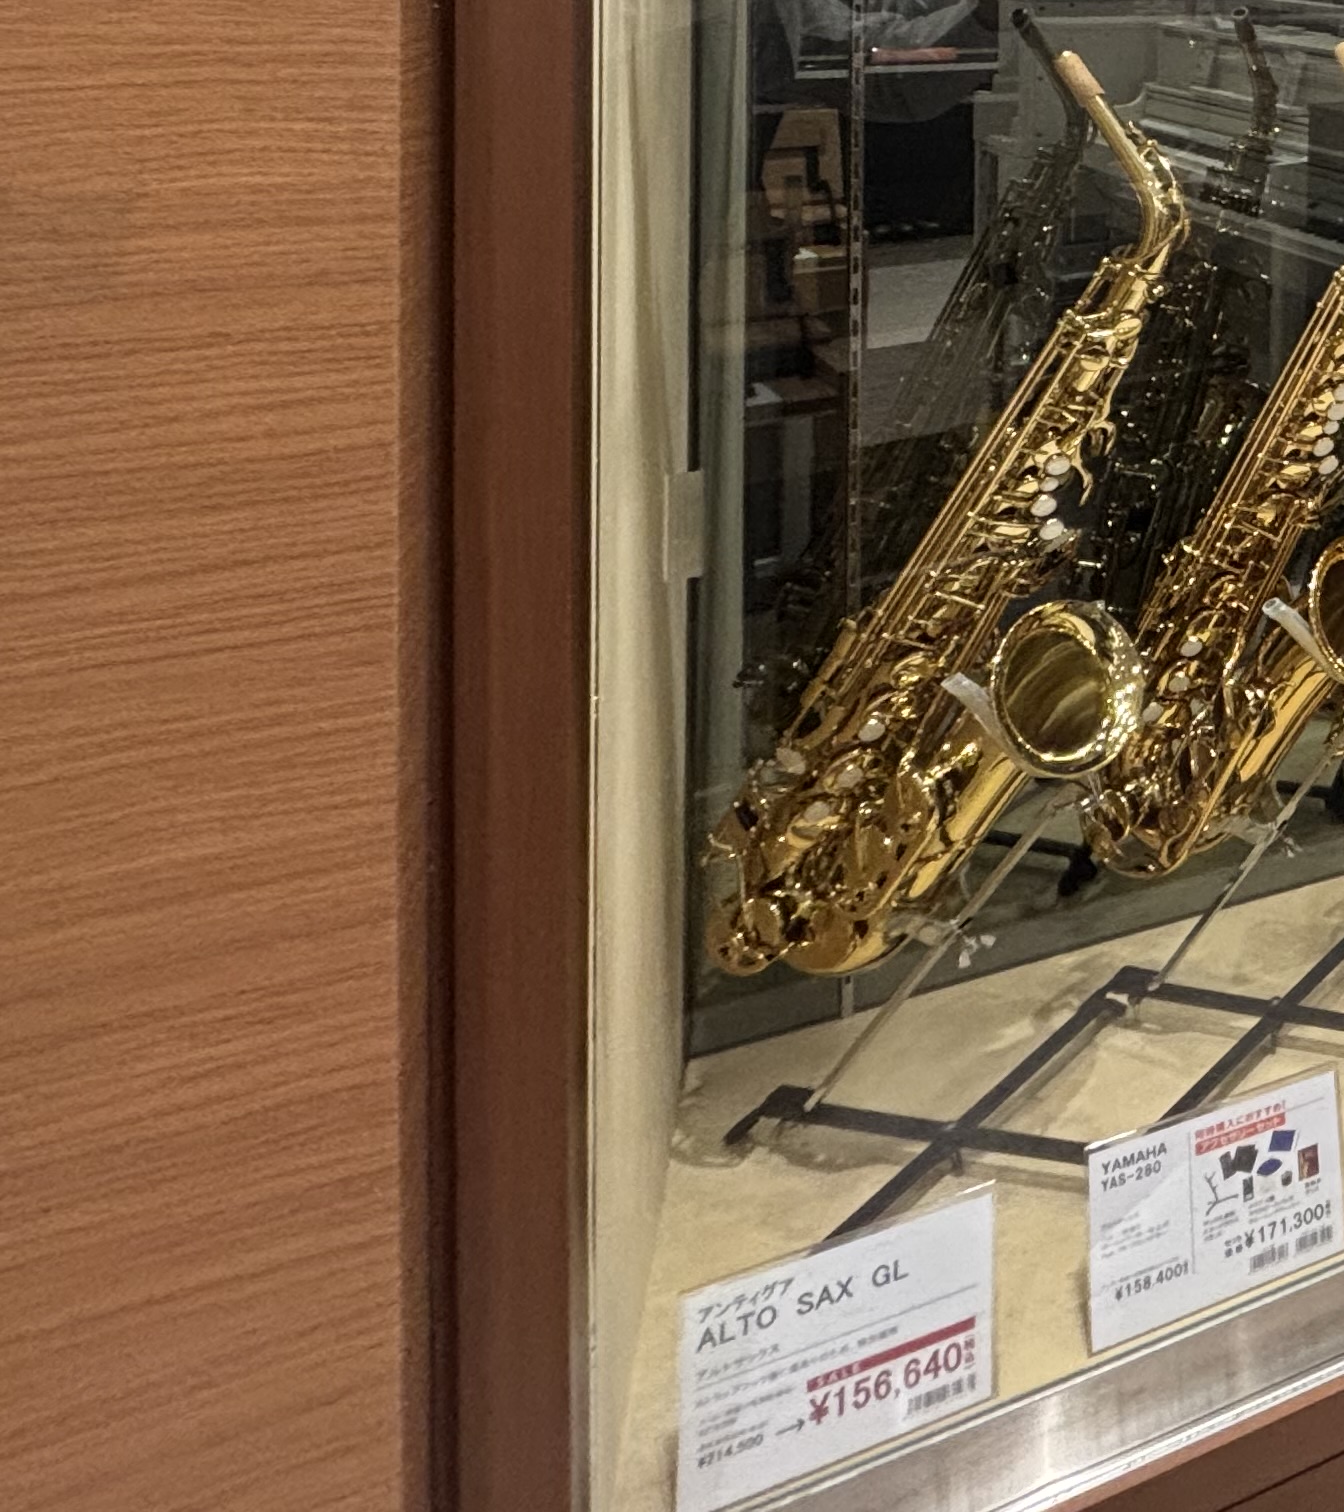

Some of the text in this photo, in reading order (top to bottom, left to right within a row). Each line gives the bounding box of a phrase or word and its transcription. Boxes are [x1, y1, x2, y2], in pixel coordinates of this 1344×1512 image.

[1101, 1142, 1167, 1175] YAMAHA
[696, 1259, 909, 1353] ALTO SAX GL
[698, 1277, 795, 1323] アンティグア
[810, 1342, 962, 1425] ¥156,640
